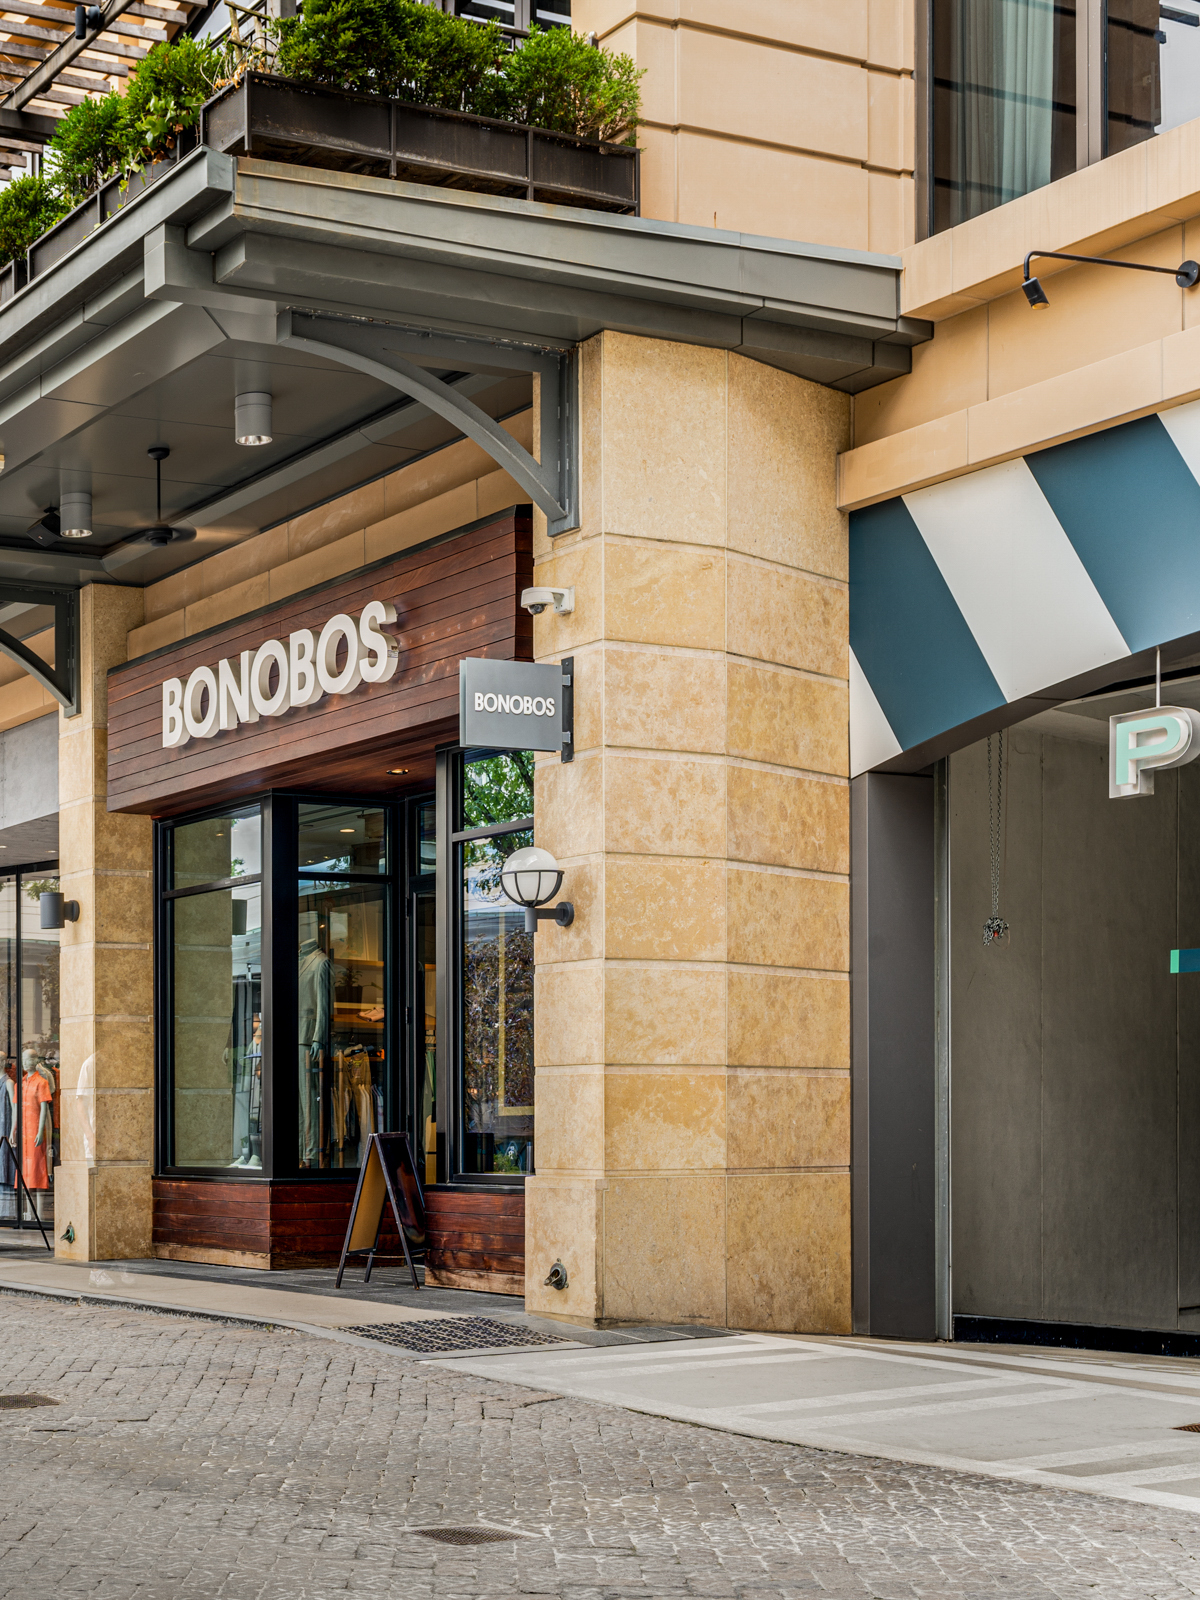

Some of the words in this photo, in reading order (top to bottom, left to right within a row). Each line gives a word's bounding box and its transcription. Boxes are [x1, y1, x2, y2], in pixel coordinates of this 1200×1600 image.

[162, 600, 397, 748] BONOBOS
[474, 692, 556, 717] BONOBOS
[1109, 706, 1193, 798] P
